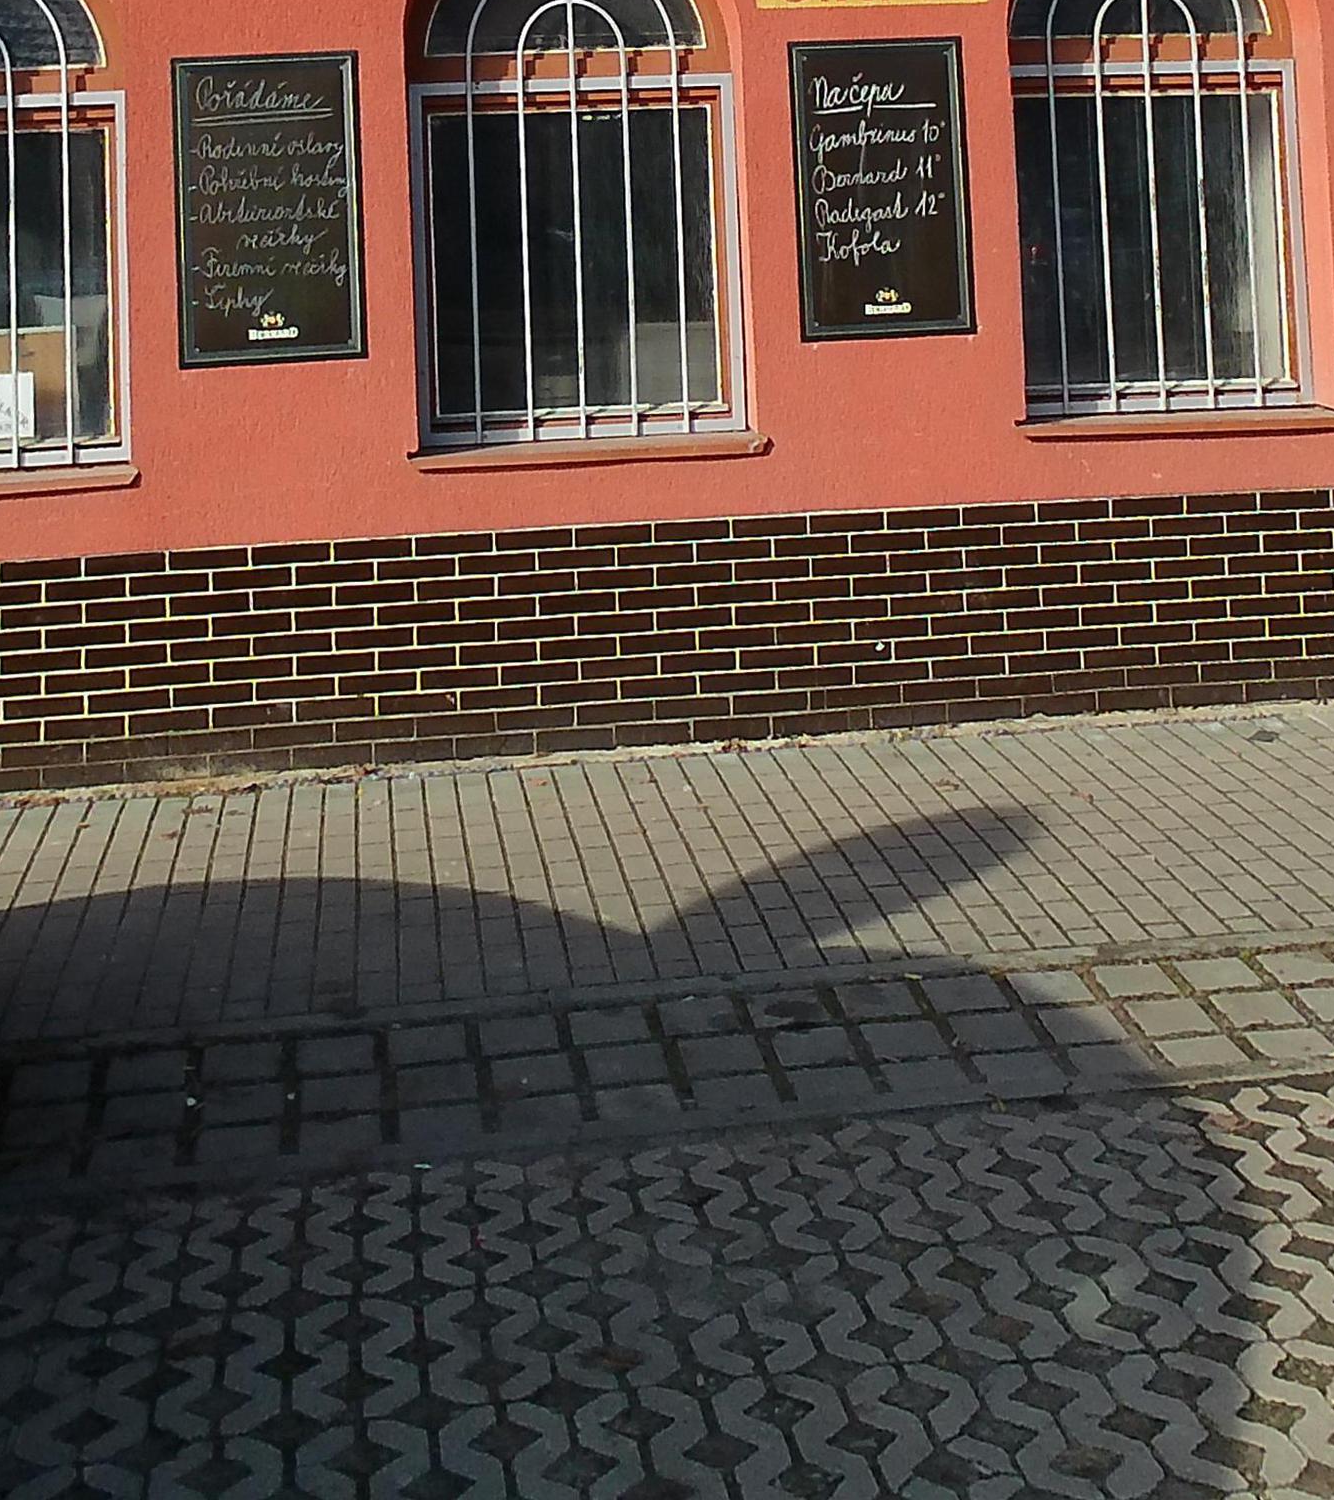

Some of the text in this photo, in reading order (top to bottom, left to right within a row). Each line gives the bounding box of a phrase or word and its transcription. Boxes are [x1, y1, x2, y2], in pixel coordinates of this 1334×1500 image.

[196, 76, 324, 111] Pořádáme
[808, 75, 848, 108] Na
[809, 119, 917, 164] Gambrinus
[812, 158, 908, 194] Bernard
[815, 191, 909, 233] Radegast
[816, 228, 901, 266] Kofola
